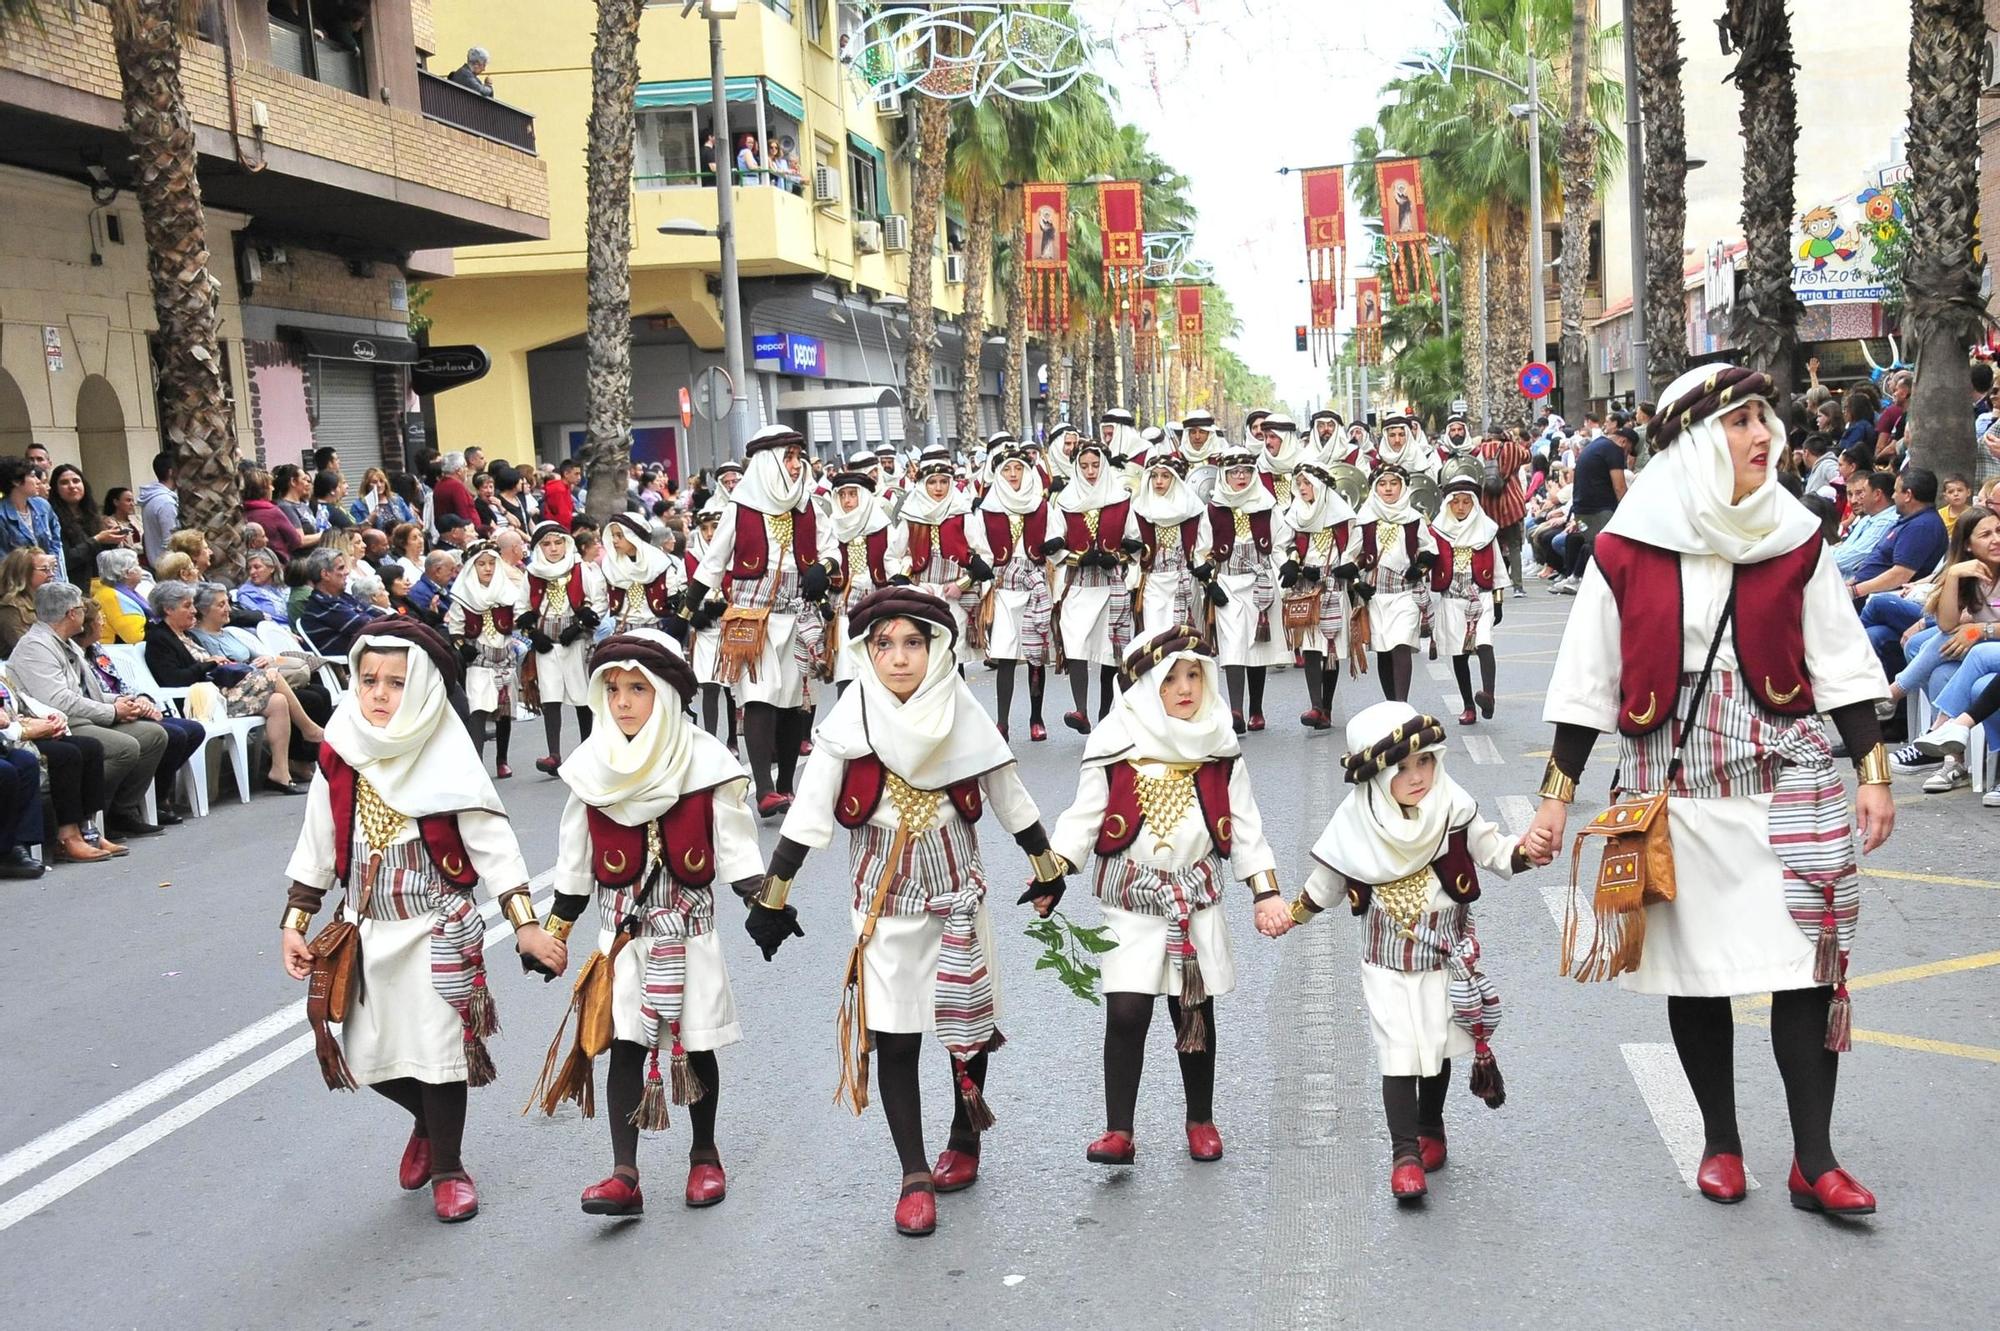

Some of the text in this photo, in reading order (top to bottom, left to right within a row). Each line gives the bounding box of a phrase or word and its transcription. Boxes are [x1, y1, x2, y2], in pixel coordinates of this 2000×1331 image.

[756, 343, 784, 352] pepco
[793, 343, 817, 371] pepco
[415, 359, 474, 373] Garland
